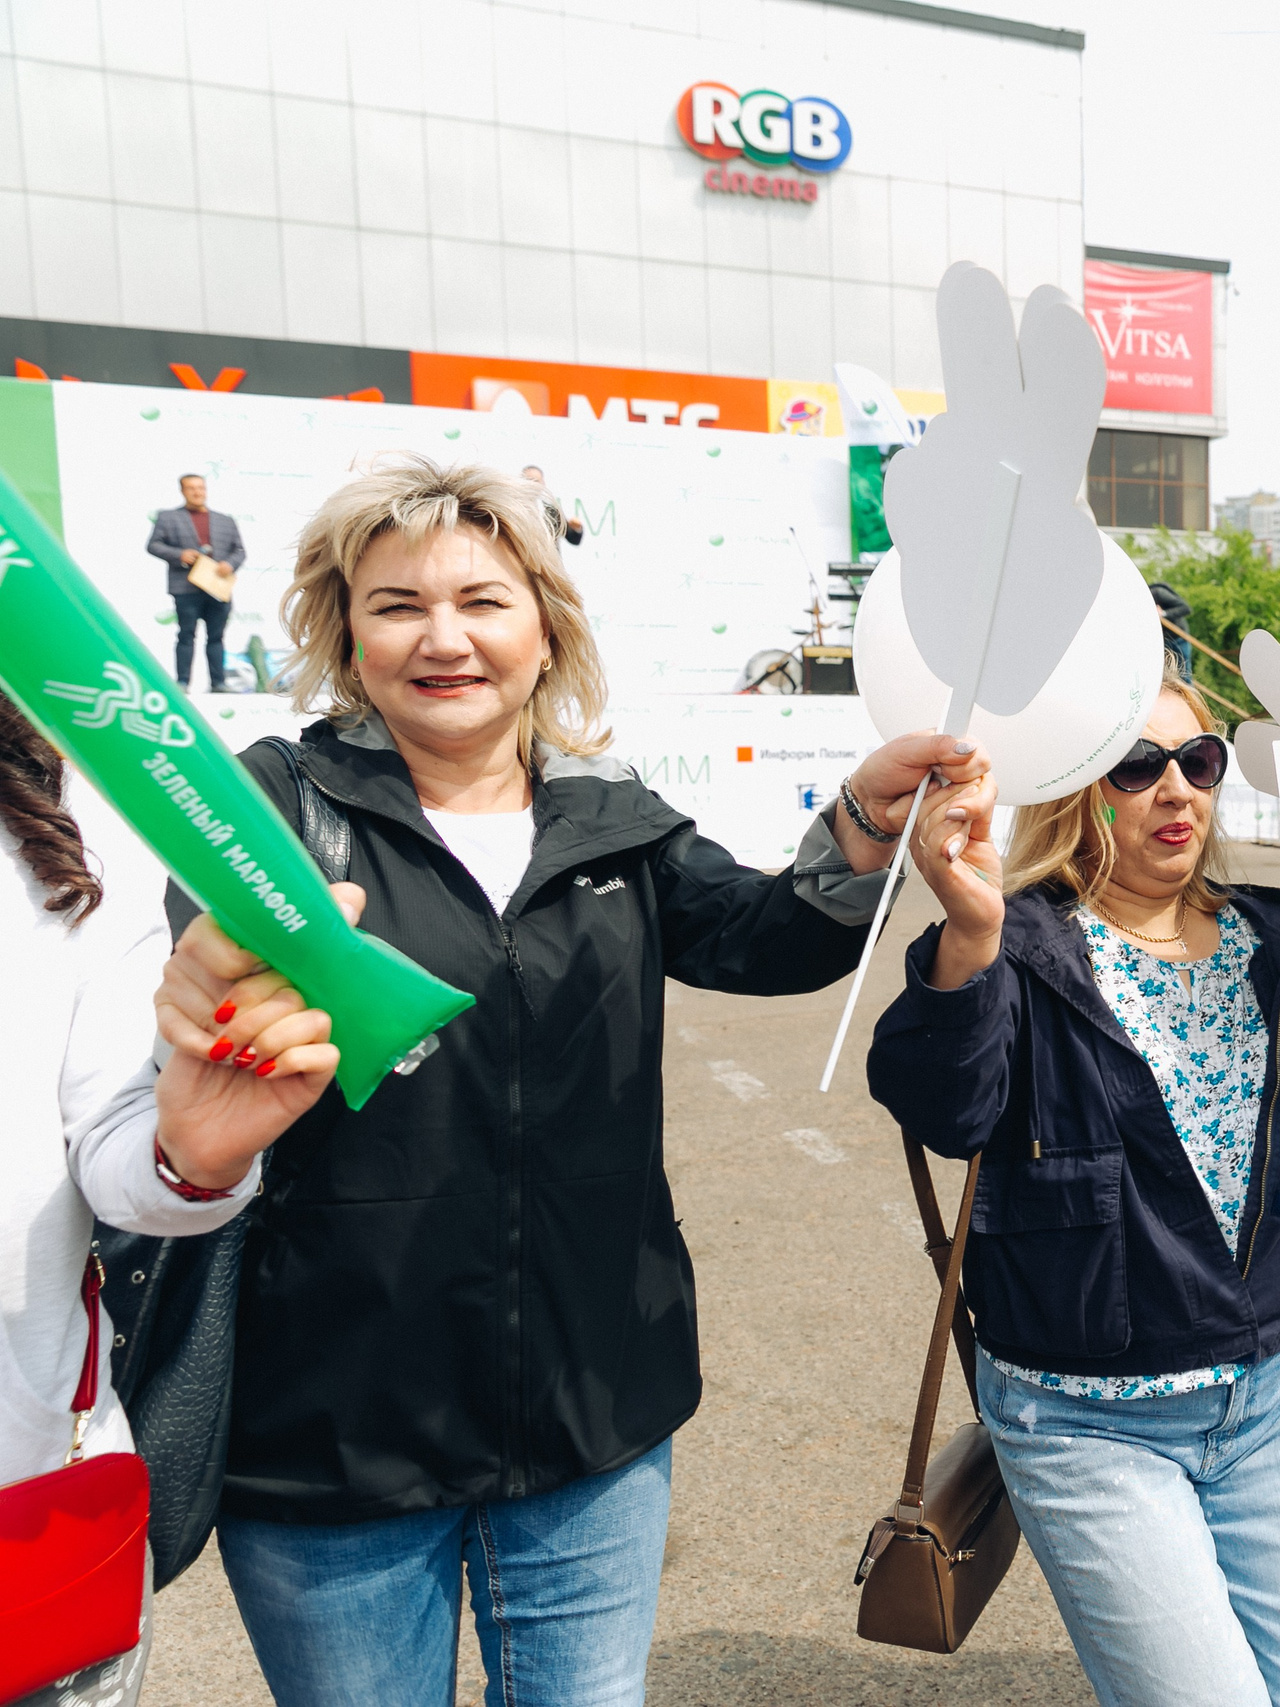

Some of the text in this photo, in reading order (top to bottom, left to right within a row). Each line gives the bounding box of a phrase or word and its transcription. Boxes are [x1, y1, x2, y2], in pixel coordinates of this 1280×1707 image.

[691, 86, 842, 161] RGB
[703, 160, 818, 204] cinema
[1088, 308, 1192, 360] VITSA
[1035, 719, 1125, 791] ЗЕЛЕНЫЙ МАРАФОН
[142, 751, 308, 934] ЗЕЛЕНЫЙ МАРАФОН
